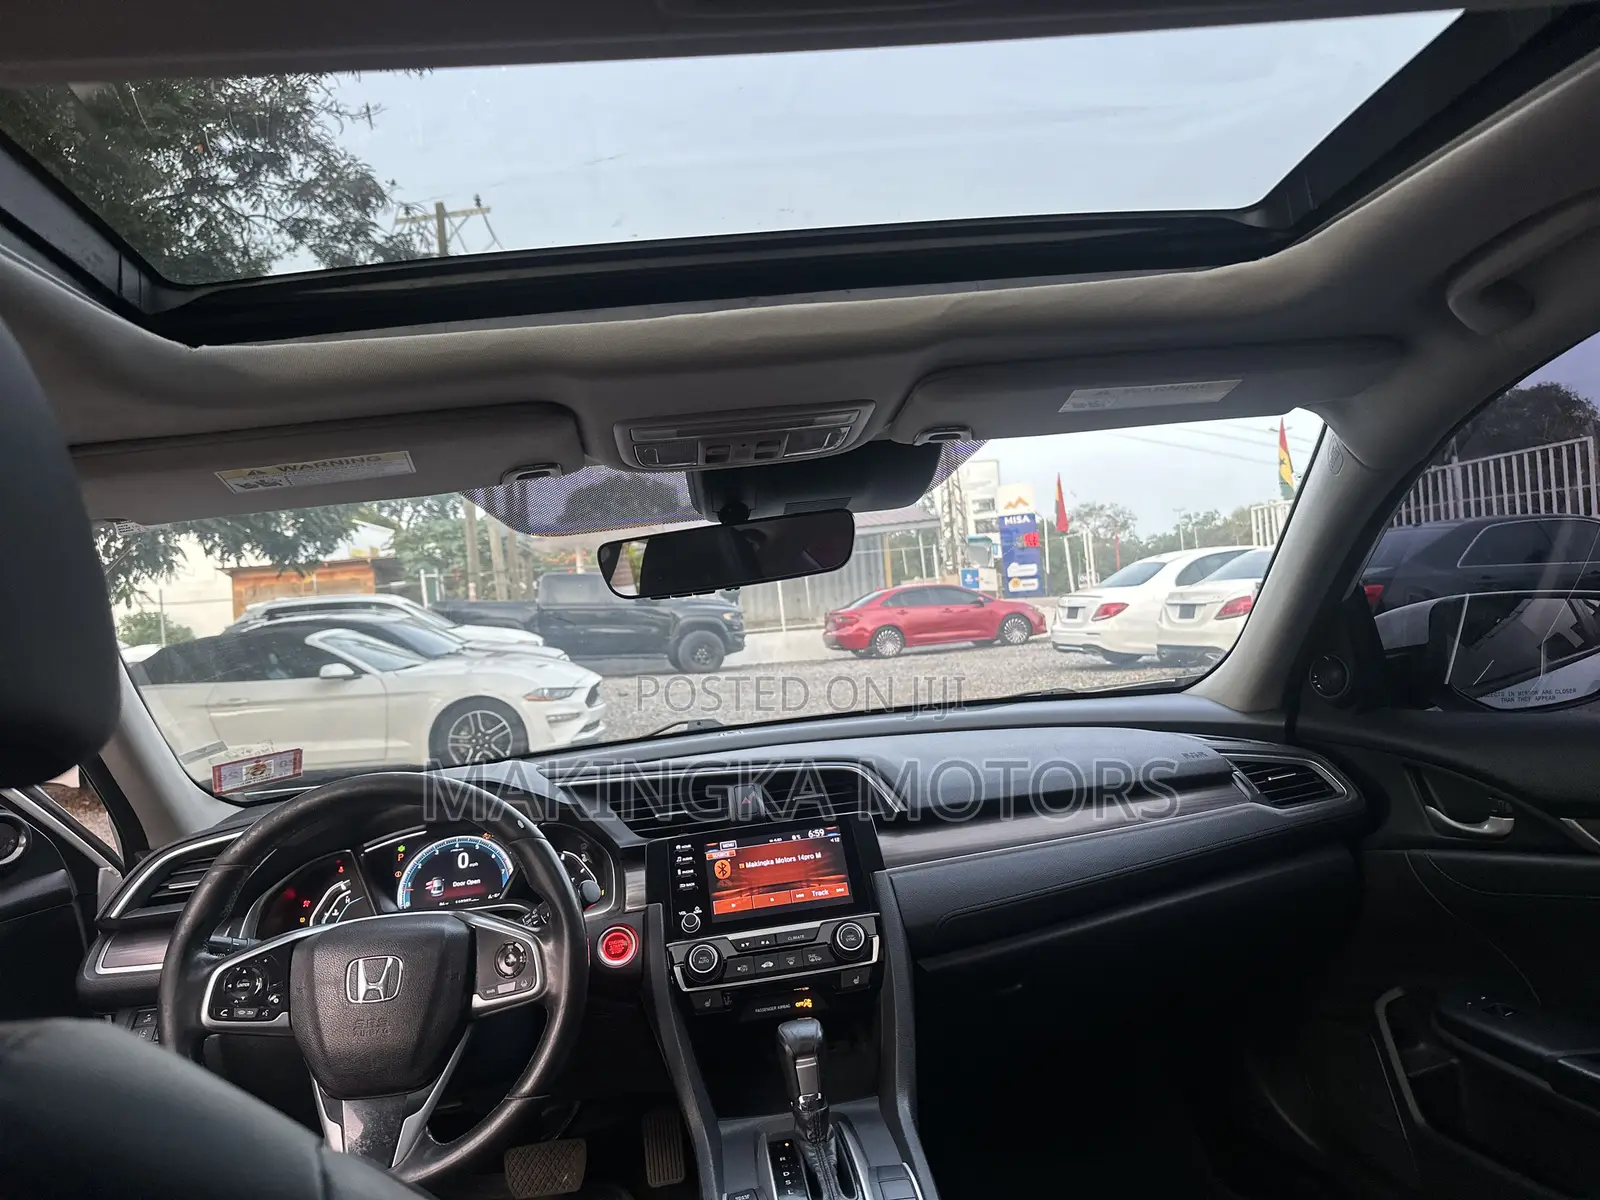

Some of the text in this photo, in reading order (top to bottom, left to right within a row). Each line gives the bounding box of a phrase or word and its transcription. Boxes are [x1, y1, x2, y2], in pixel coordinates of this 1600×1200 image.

[276, 455, 382, 473] WARNING
[1004, 514, 1031, 525] MISA
[1555, 687, 1577, 695] CLOSER
[808, 828, 825, 838] 6:59
[397, 853, 404, 862] P
[457, 852, 469, 869] 0
[745, 859, 775, 869] Makingka
[775, 856, 797, 865] Motors
[797, 853, 815, 863] 14pro
[452, 878, 481, 888] Door Open
[811, 889, 829, 897] Track
[755, 1003, 792, 1013] PASSENGER AIRBAG
